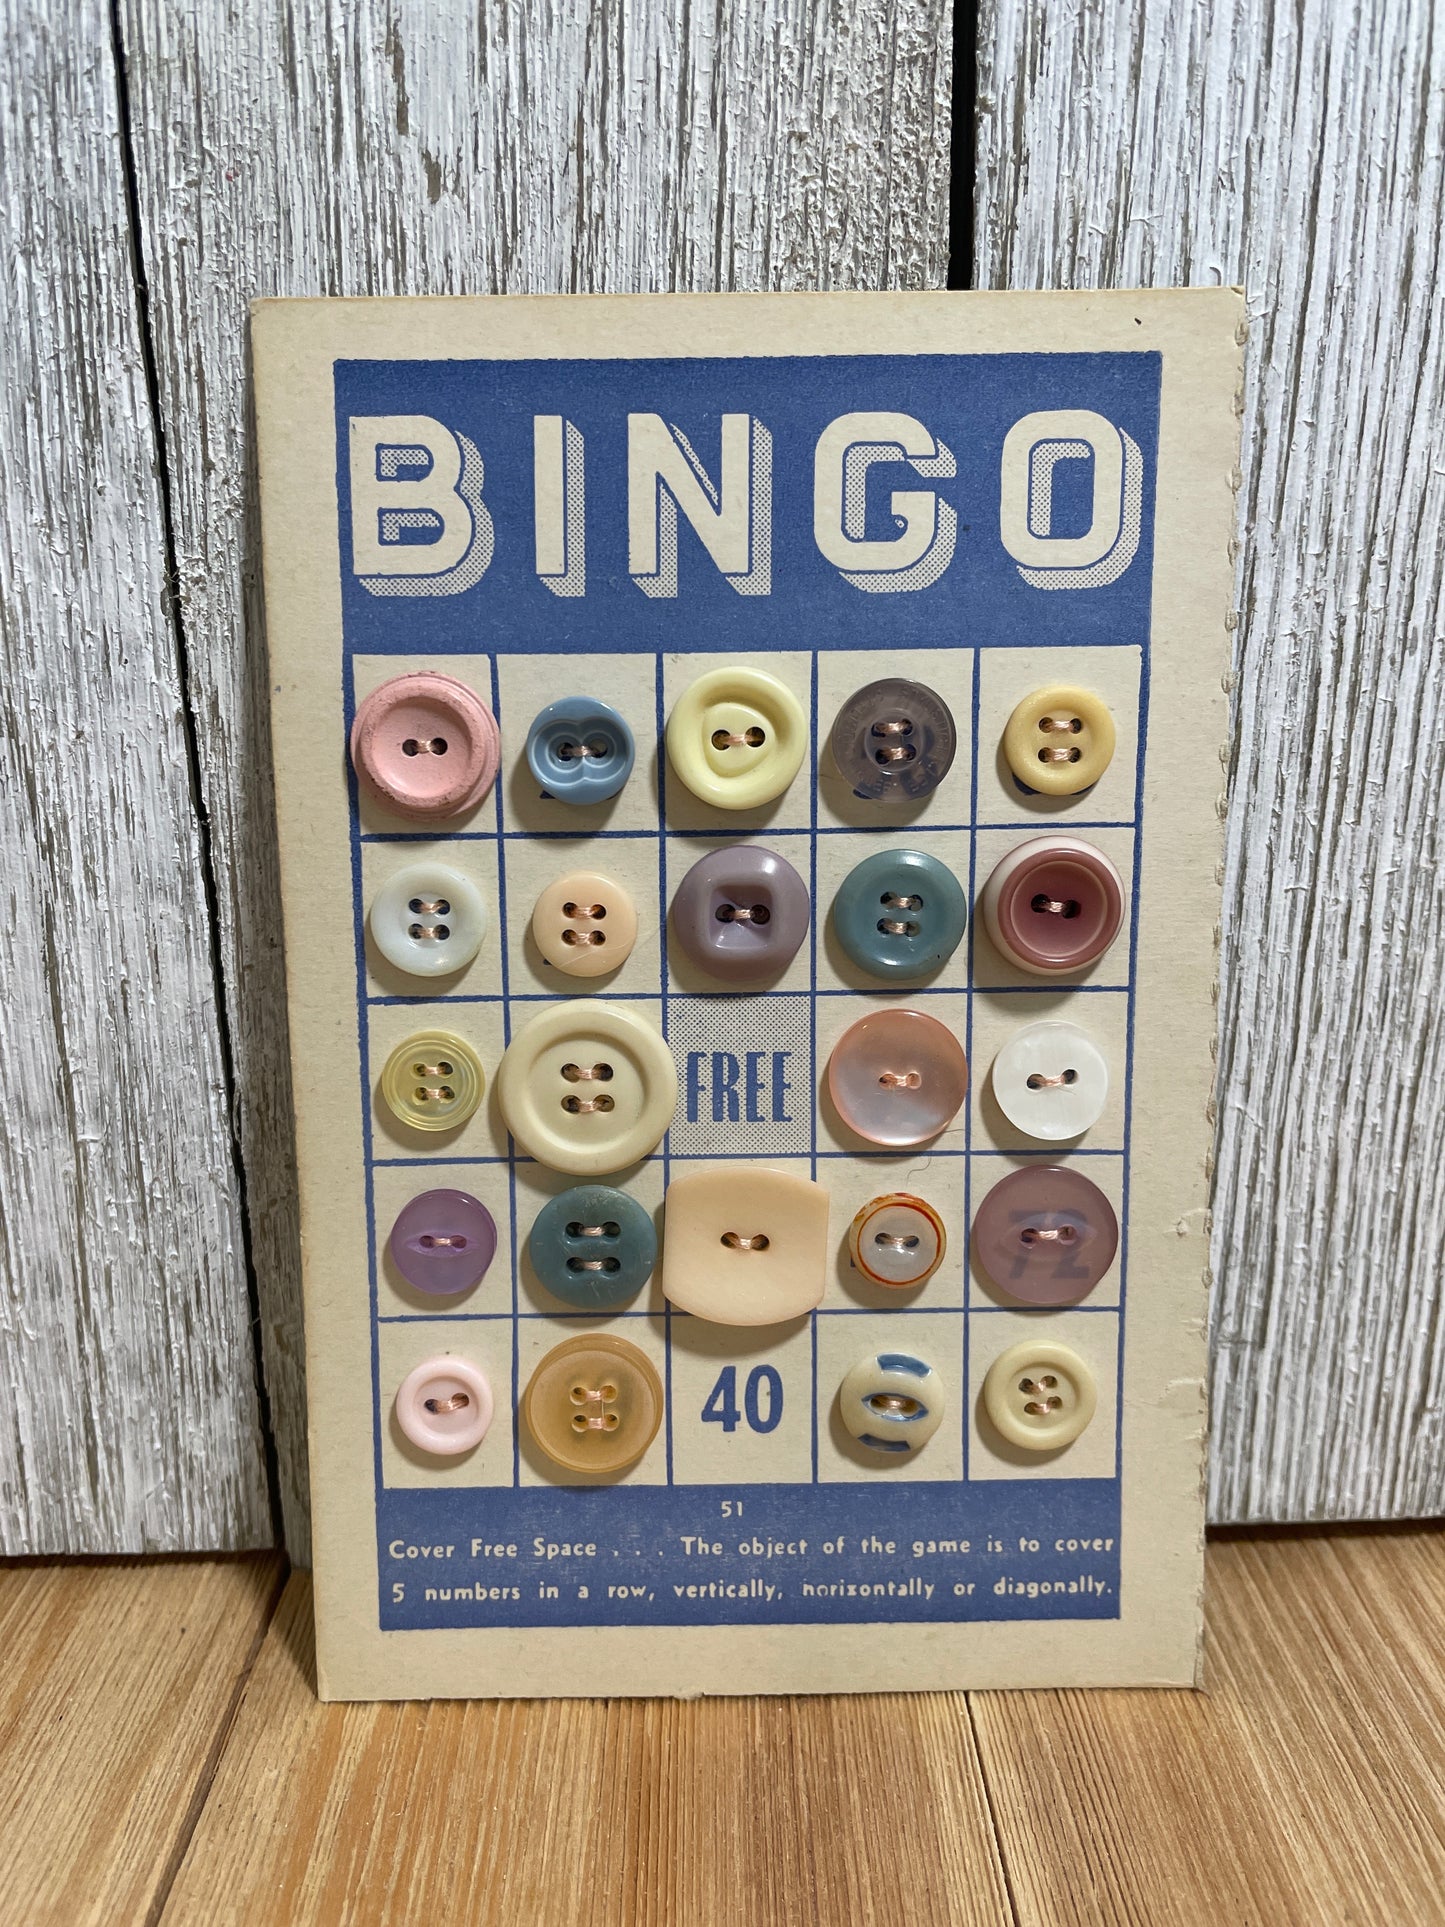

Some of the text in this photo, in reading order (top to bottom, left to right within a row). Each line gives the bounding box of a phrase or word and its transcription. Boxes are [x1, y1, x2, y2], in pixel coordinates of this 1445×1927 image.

[349, 410, 1146, 598] BINGO
[686, 1051, 793, 1123] FREE
[1008, 1209, 1090, 1280] 72
[701, 1364, 784, 1434] 40
[720, 1500, 743, 1518] 51
[388, 1539, 455, 1559] Cover
[471, 1538, 518, 1558] Free
[533, 1537, 597, 1560] Space
[680, 1536, 723, 1556] The
[738, 1536, 808, 1559] object
[822, 1535, 845, 1554] of
[861, 1535, 896, 1554] the
[912, 1540, 971, 1558] game
[987, 1534, 1003, 1553] is
[1019, 1537, 1040, 1552] to
[1055, 1538, 1114, 1552] cover
[392, 1582, 405, 1603] 5
[425, 1581, 521, 1601] numbers
[539, 1581, 559, 1599] in
[577, 1585, 589, 1599] a
[608, 1585, 655, 1601] row,
[673, 1578, 783, 1602] vertically,
[953, 1583, 976, 1596] or
[993, 1575, 1112, 1599] diagonally.
